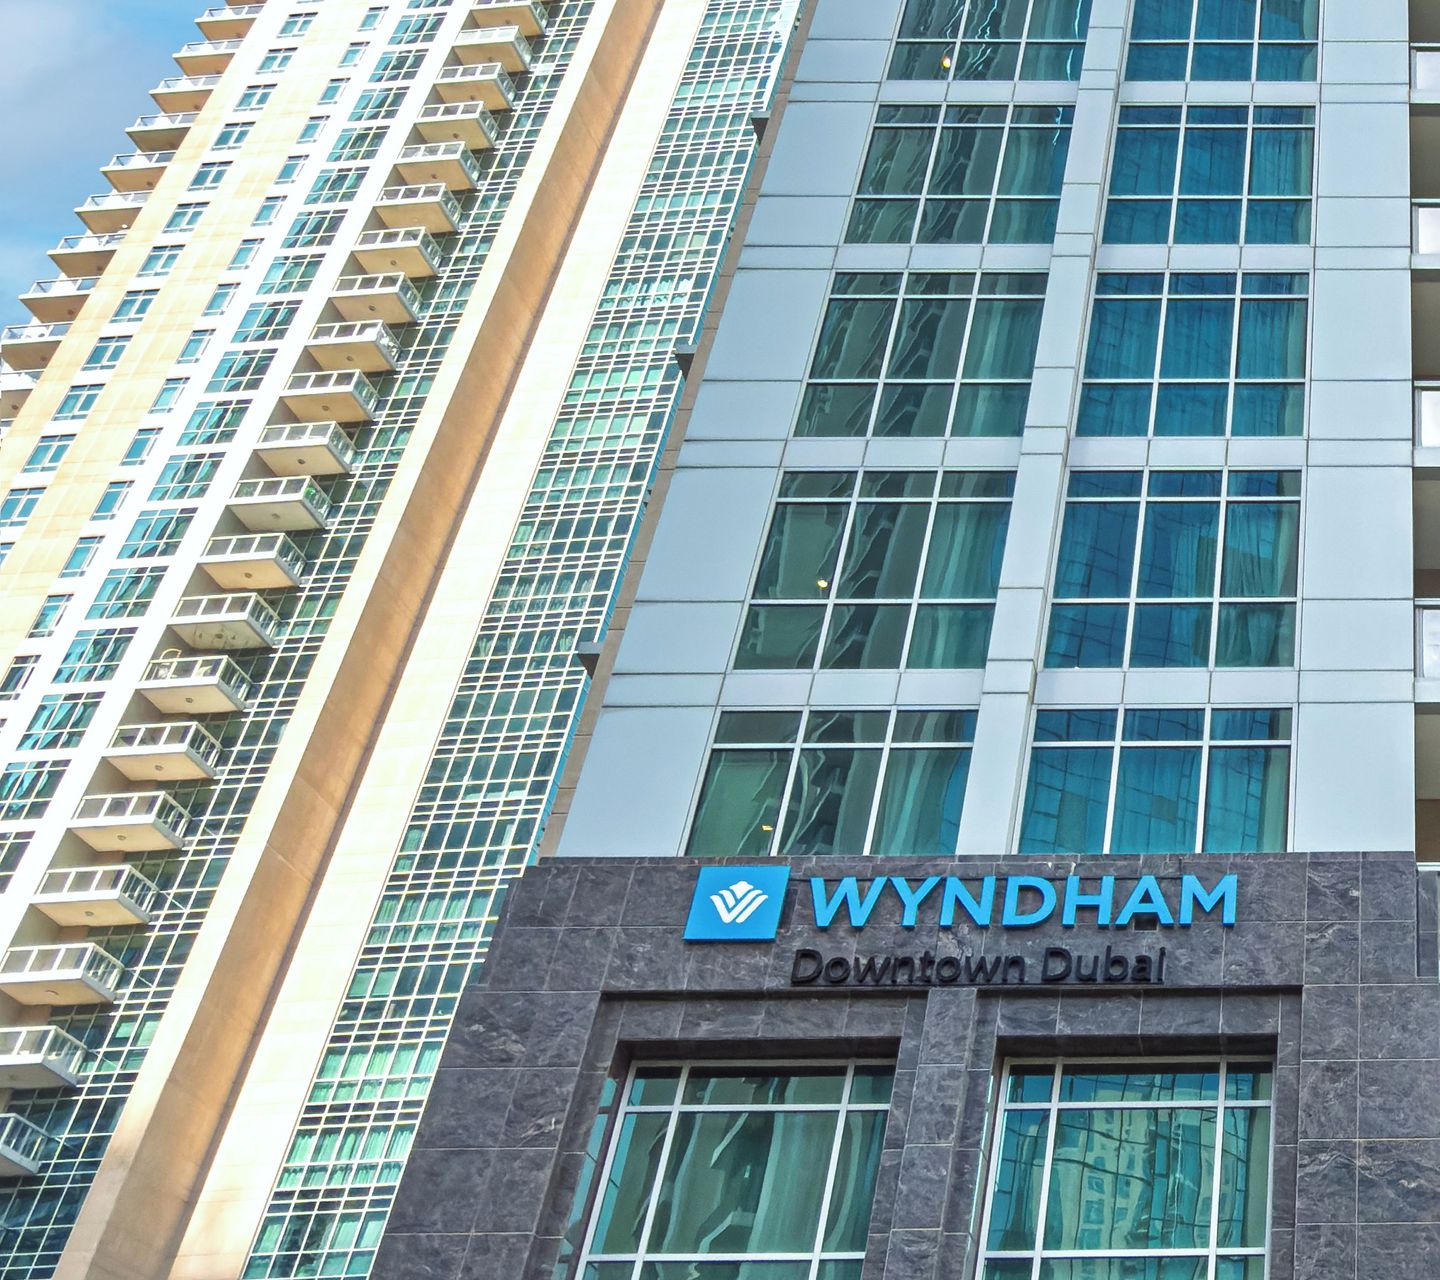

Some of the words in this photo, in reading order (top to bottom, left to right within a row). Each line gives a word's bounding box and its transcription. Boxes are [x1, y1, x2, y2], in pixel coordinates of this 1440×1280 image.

[810, 873, 1239, 930] WYNDHAM
[790, 948, 1026, 987] Downtown
[1040, 944, 1167, 985] Dubai
